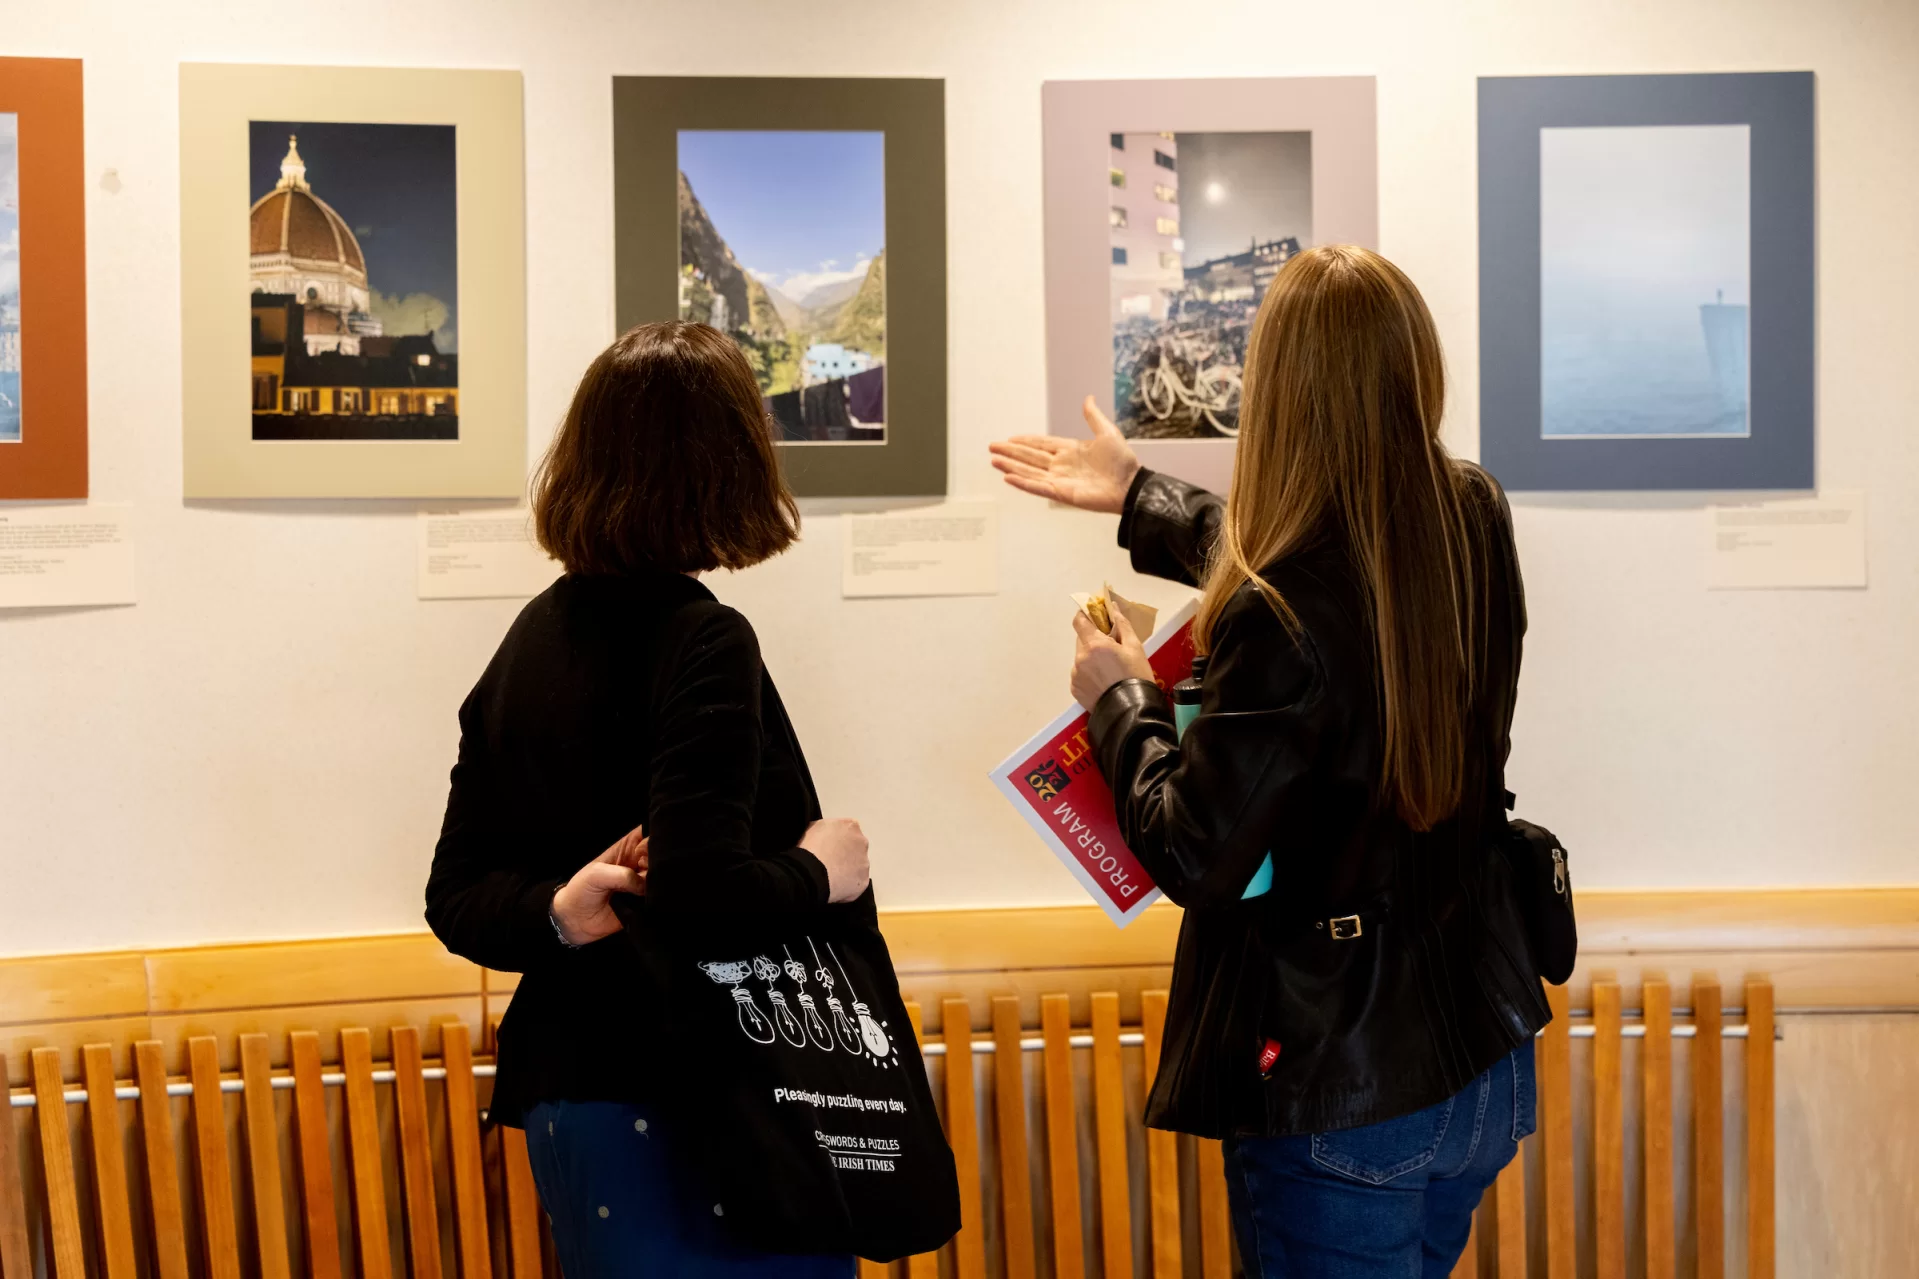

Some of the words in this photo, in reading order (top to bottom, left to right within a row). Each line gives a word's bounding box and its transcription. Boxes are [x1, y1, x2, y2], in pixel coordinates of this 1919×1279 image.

[1053, 801, 1139, 898] PROGRAM
[774, 1087, 826, 1108] Pleasingly
[827, 1094, 865, 1111] puzzling
[865, 1099, 888, 1113] every
[889, 1098, 907, 1114] day.
[859, 1137, 867, 1149] &
[868, 1138, 900, 1151] PUZZLES
[838, 1157, 864, 1170] IRISH
[865, 1159, 896, 1172] TIMES
